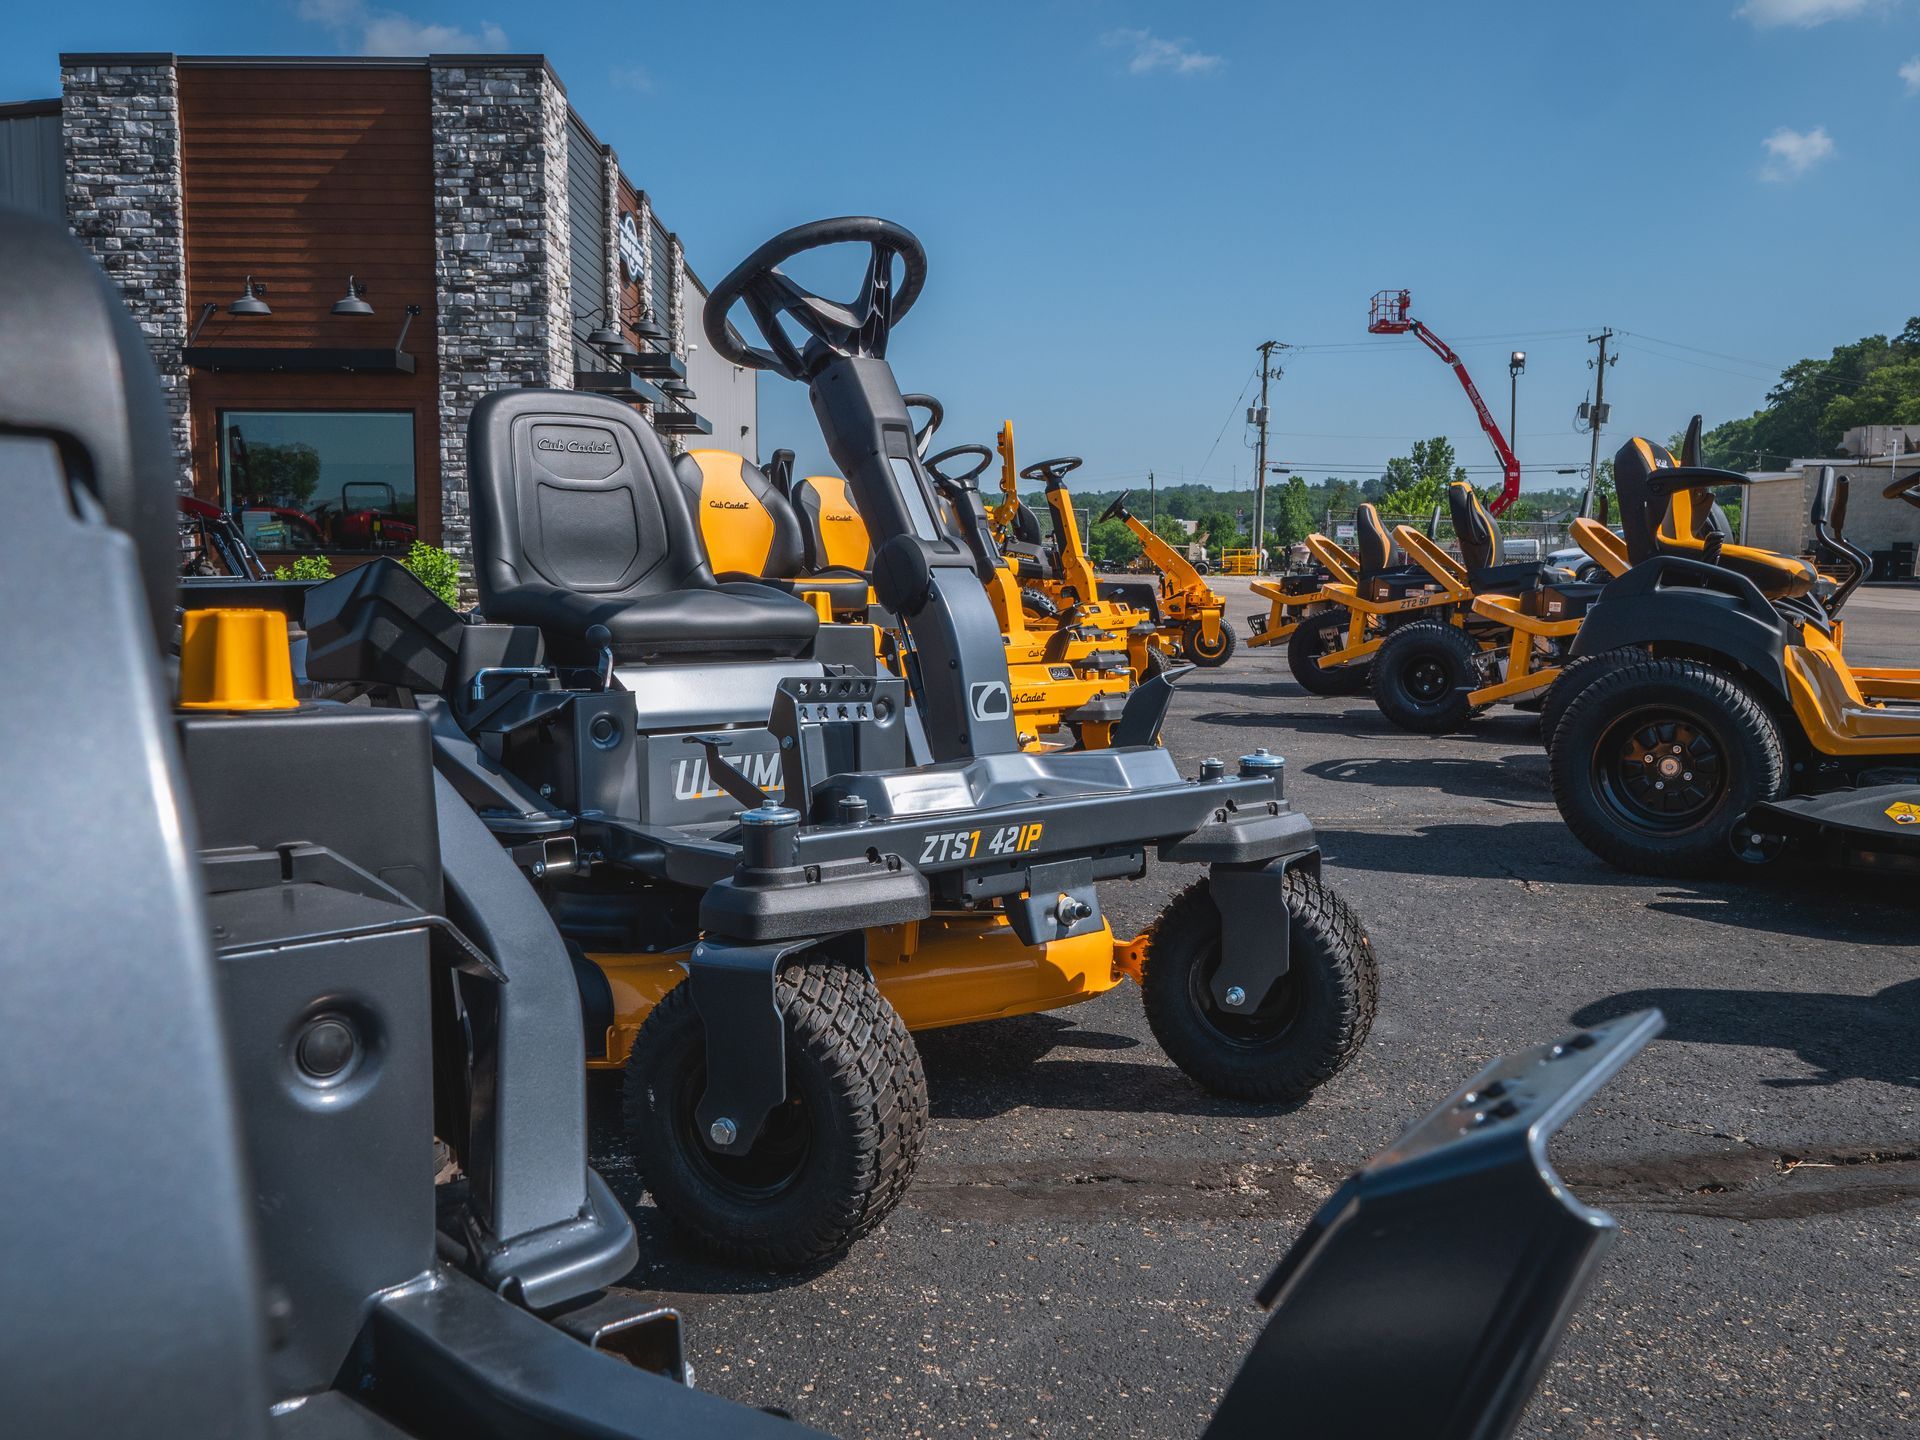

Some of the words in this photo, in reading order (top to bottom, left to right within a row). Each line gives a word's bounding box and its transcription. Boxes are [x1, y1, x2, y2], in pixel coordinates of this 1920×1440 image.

[538, 438, 565, 452] Cub
[567, 440, 612, 455] Cadet
[709, 500, 724, 509] Cub
[724, 501, 749, 510] Cadet
[1028, 650, 1040, 658] Cub
[1012, 694, 1020, 704] ub
[1020, 692, 1046, 703] Cadet
[675, 752, 785, 800] ULTIM
[918, 830, 982, 865] ZTS1
[988, 823, 1043, 855] 42IP
